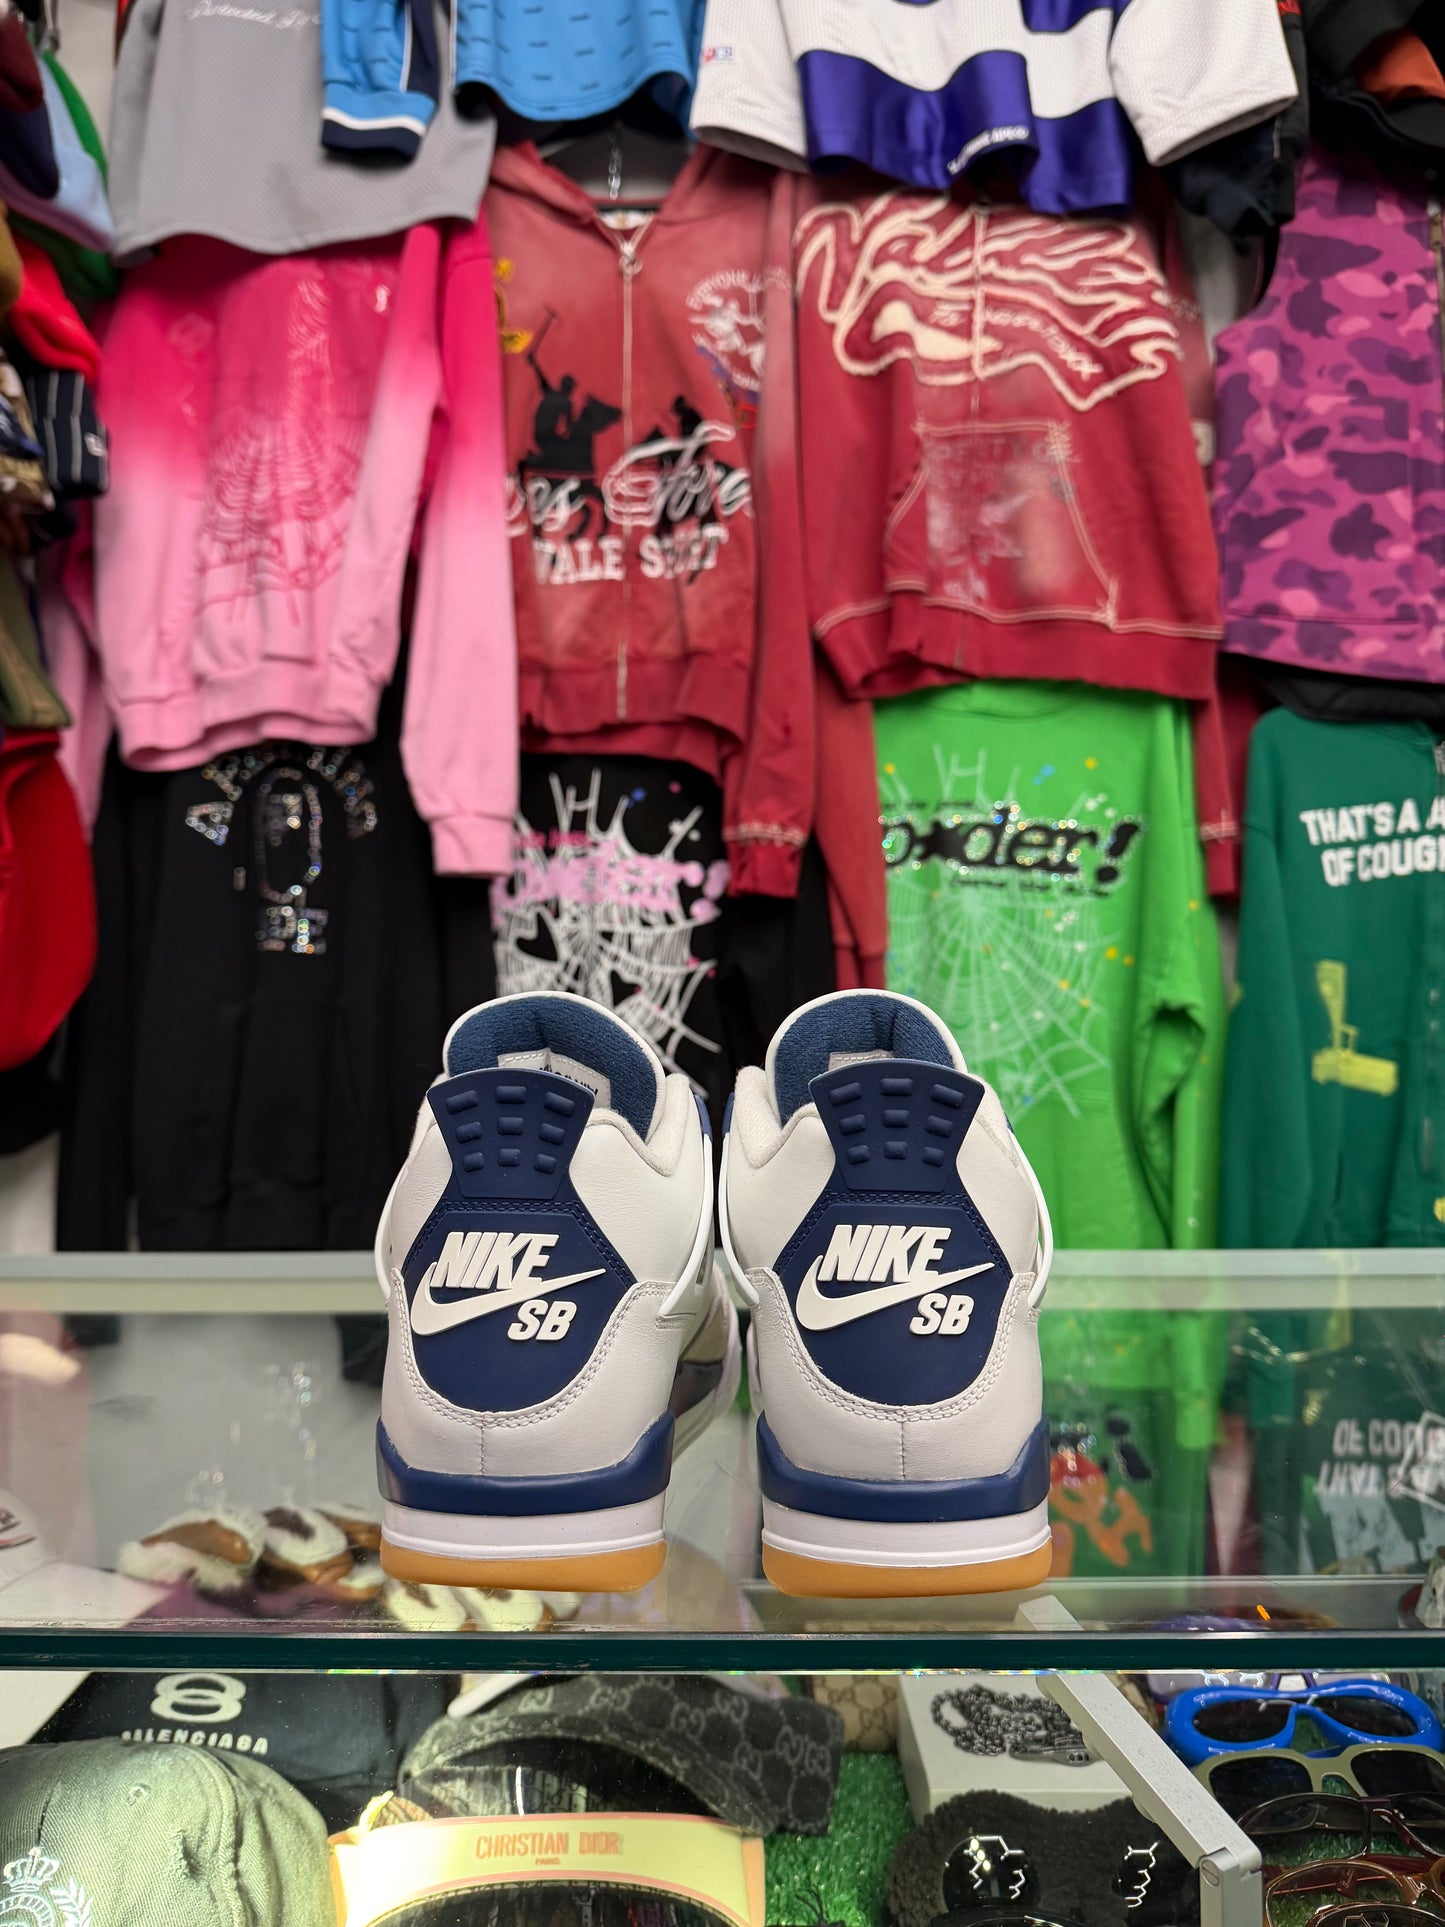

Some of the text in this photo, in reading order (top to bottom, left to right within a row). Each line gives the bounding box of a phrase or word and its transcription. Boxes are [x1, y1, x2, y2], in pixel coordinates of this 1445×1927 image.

[1299, 801, 1396, 846] THAT'S
[1396, 798, 1420, 834] A
[1321, 834, 1445, 887] OF COUG
[430, 1231, 560, 1290] NIKE
[817, 1224, 951, 1283] NIKE
[507, 1299, 577, 1341] SB
[909, 1292, 974, 1335] SB
[475, 1831, 620, 1859] CHRISTIAN DIOR
